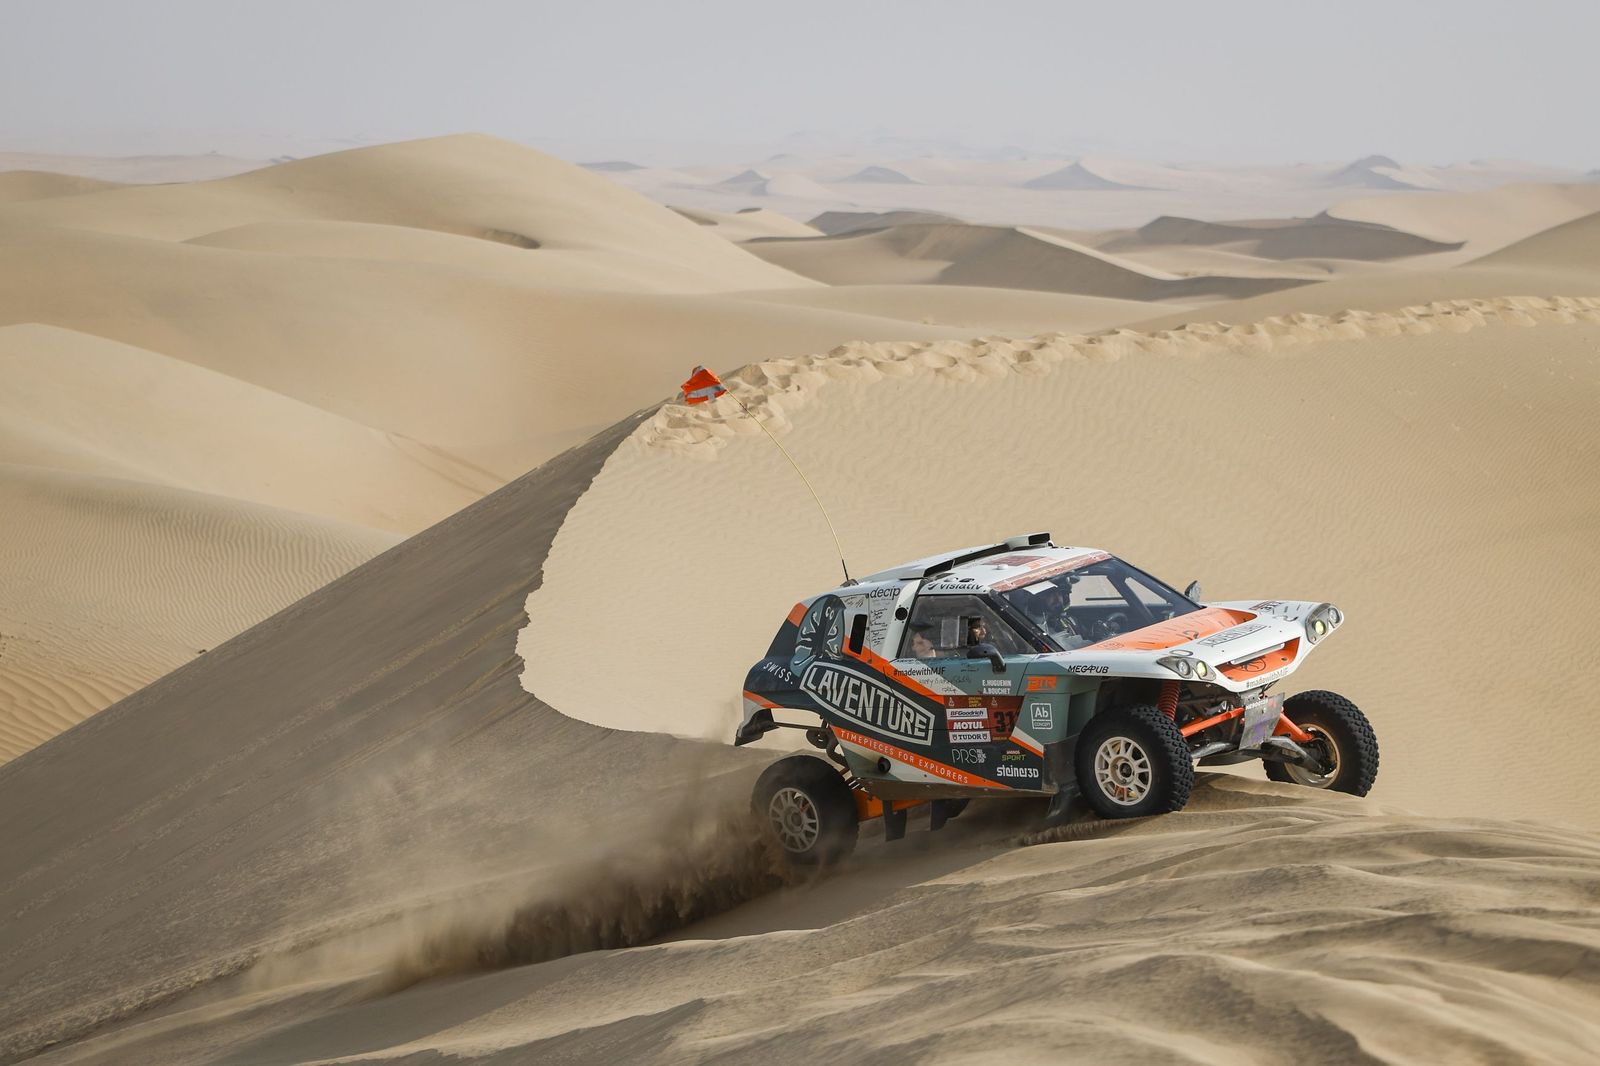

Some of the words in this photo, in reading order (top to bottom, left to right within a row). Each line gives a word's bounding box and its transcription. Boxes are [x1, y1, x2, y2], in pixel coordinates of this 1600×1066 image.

[806, 667, 928, 737] LAVENTURE
[950, 710, 984, 718] BFGoodrich
[1034, 706, 1049, 718] Ab
[953, 721, 984, 730] MOTUL
[958, 733, 982, 741] TUDOR
[840, 730, 894, 755] TIMEPIECES
[898, 751, 914, 763] FOR
[919, 757, 968, 784] EXPLORERS
[951, 748, 977, 764] PRS
